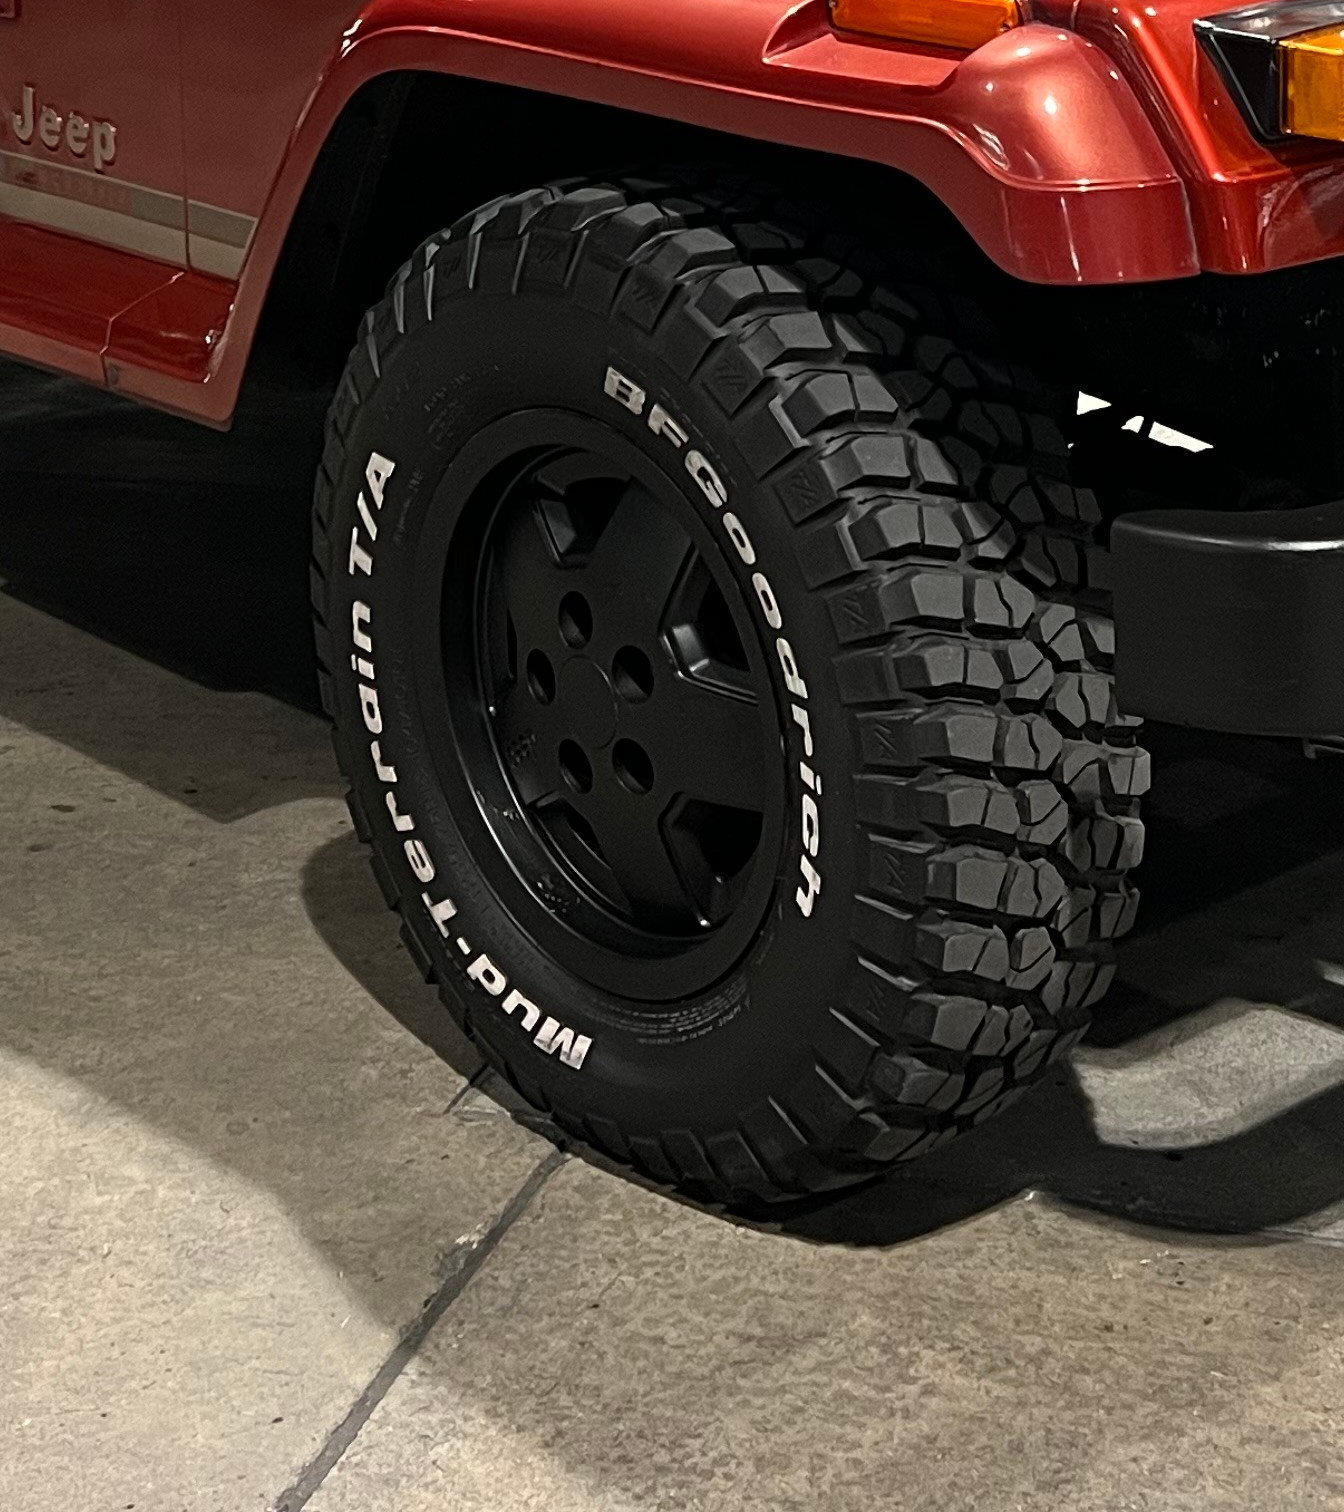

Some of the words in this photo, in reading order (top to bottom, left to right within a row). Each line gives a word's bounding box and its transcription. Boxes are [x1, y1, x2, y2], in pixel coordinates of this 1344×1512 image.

[11, 85, 117, 171] Jeep
[348, 449, 397, 577] T/A
[603, 364, 824, 920] BFGoodrich
[348, 598, 594, 1072] Mud-Terrain
